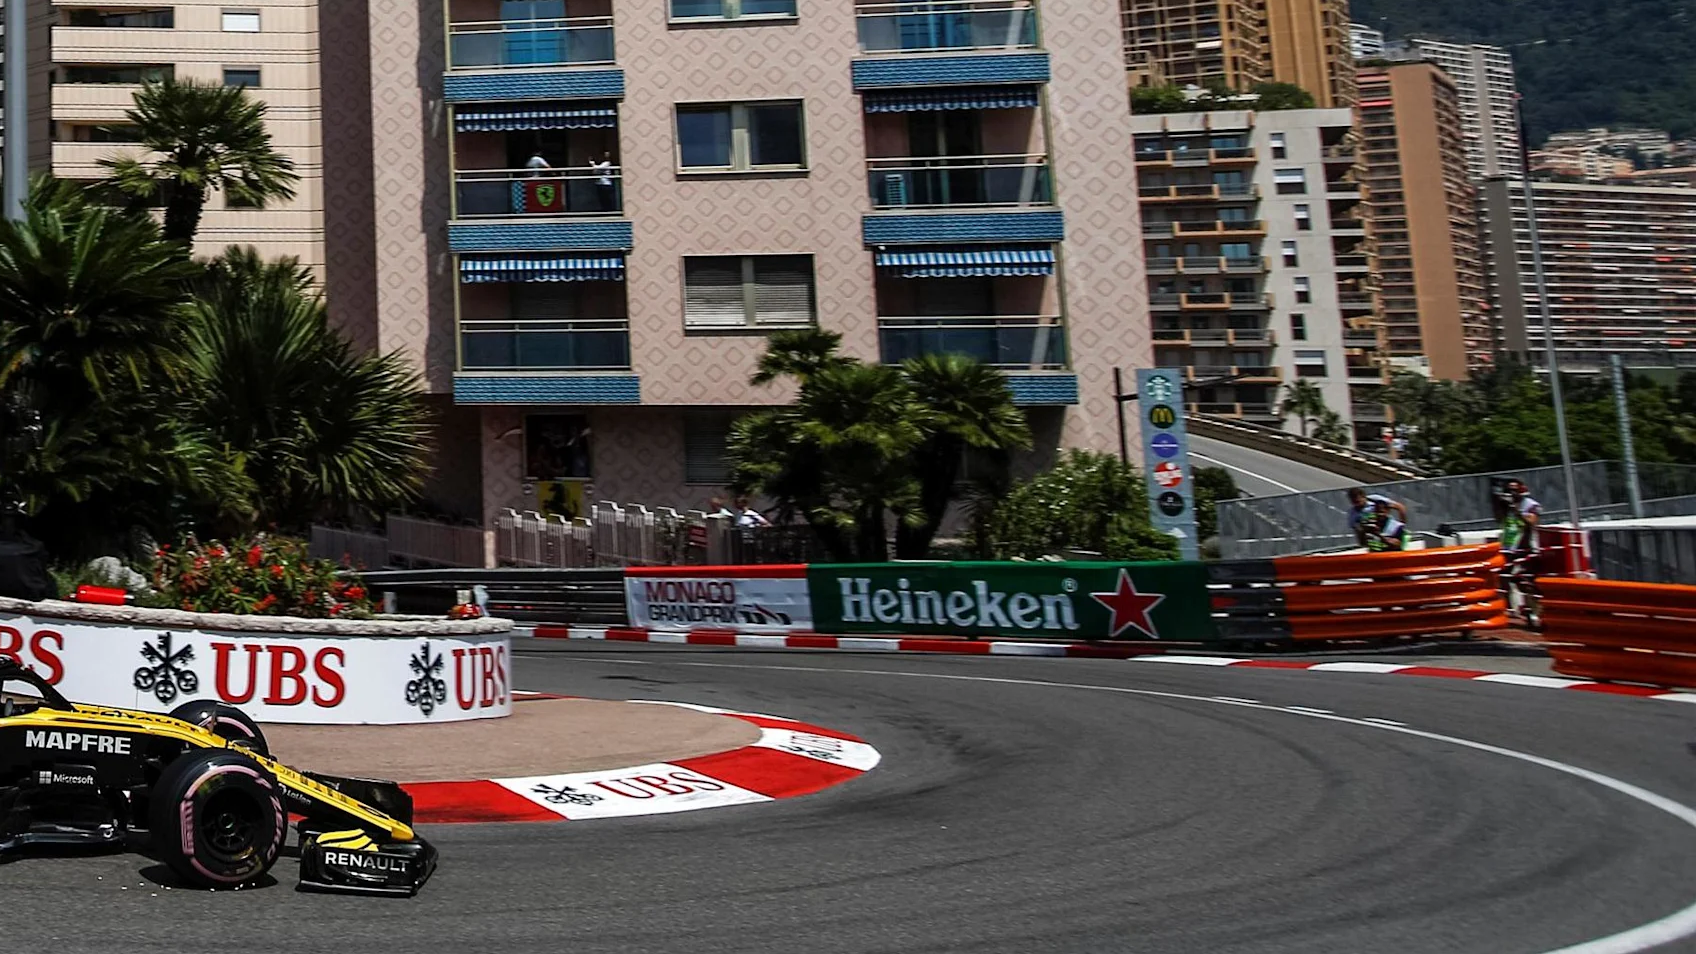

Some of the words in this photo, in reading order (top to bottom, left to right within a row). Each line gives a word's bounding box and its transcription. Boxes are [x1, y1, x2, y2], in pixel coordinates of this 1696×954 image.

[644, 581, 735, 604] MONACO
[836, 576, 1080, 631] Heineken
[211, 643, 346, 707] UBS
[451, 646, 506, 710] UBS
[25, 729, 132, 755] MAPFRE
[53, 773, 94, 785] Microsoft
[589, 771, 725, 799] UBS
[324, 851, 410, 873] RENAULT
